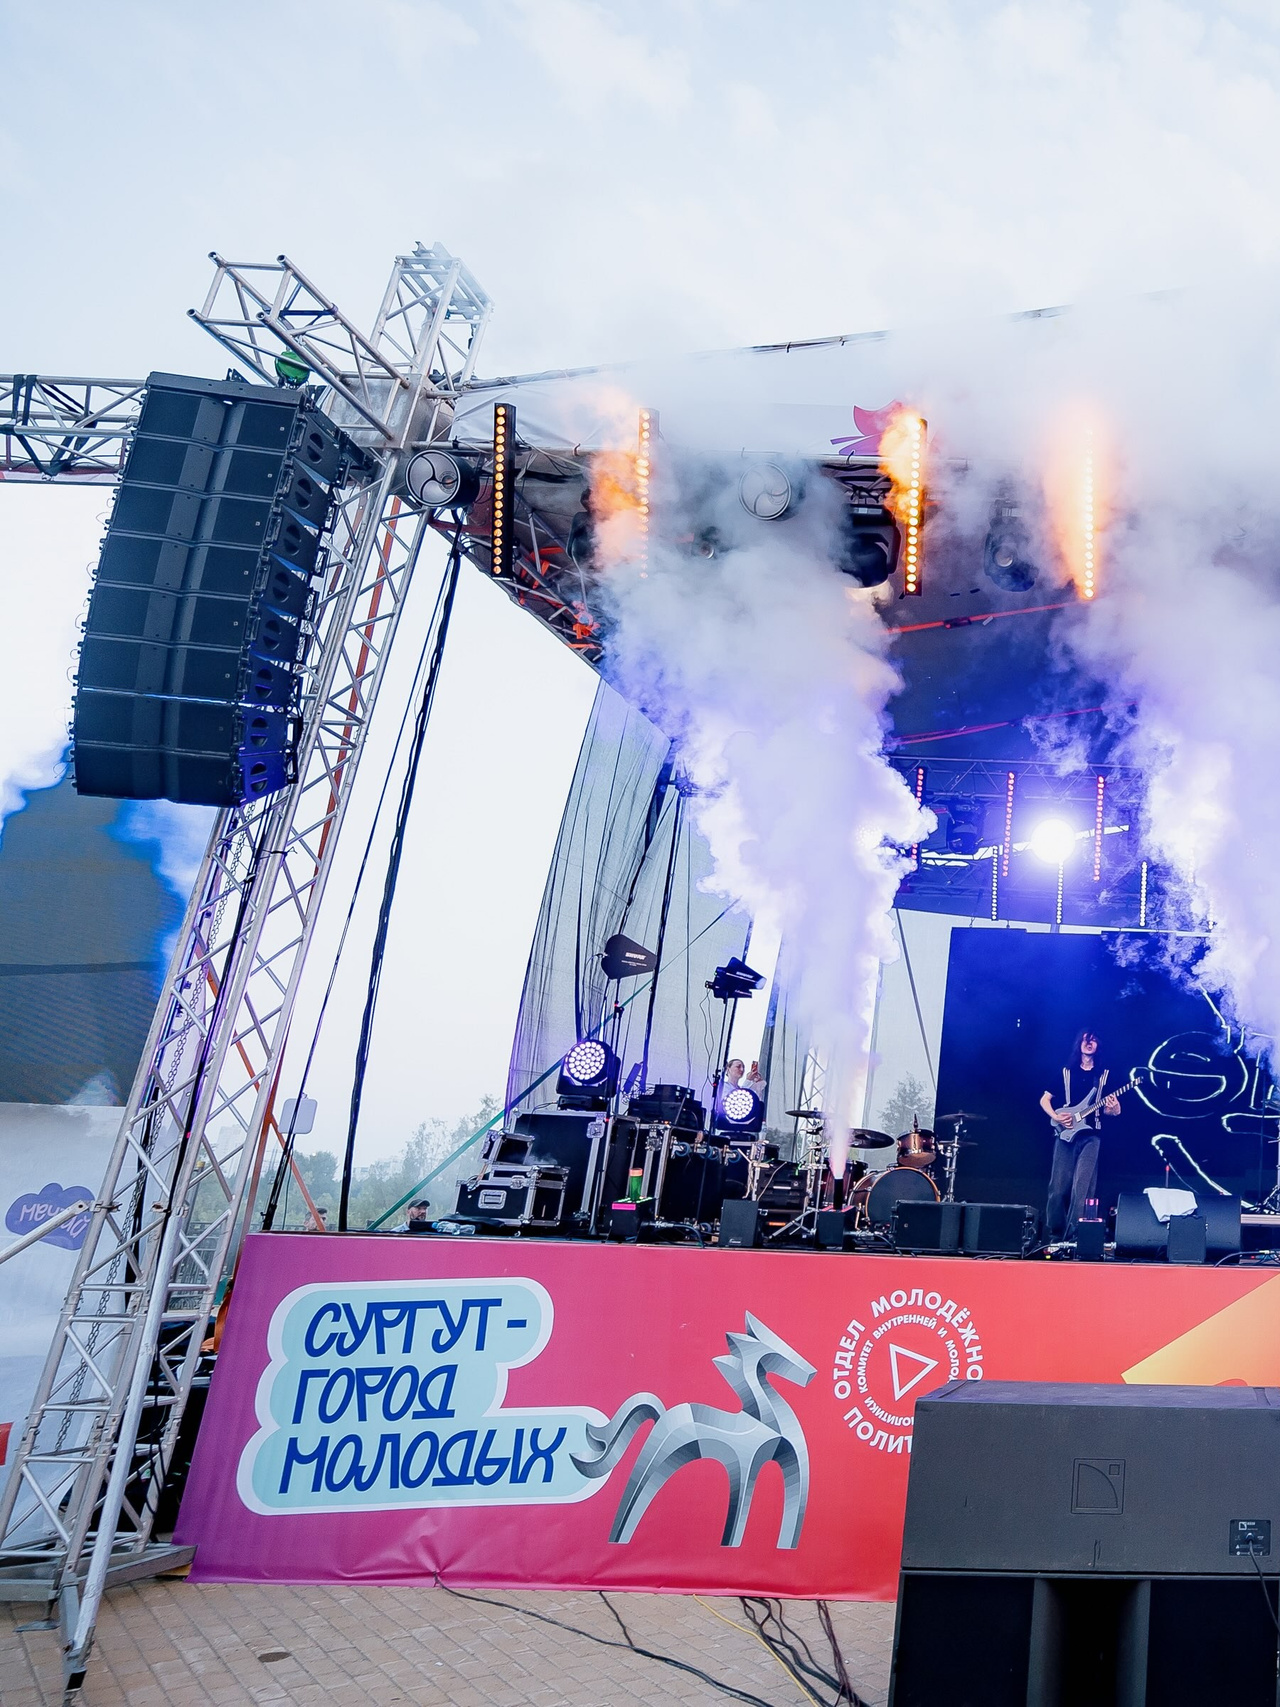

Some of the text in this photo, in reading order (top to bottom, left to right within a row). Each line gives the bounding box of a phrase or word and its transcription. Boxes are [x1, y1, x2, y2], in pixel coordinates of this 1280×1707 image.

[833, 1288, 984, 1400] ОТДЕЛ МОЛОДЁЖНО
[857, 1339, 874, 1394] КОМИТЕТ
[872, 1314, 938, 1340] ВНУТРЕННЕЙ
[937, 1326, 949, 1338] И
[292, 1364, 458, 1426] ГОРОД
[864, 1396, 915, 1427] ОЛИТИКИ
[279, 1426, 567, 1495] МОЛОДЫХ
[843, 1406, 914, 1454] ПОЛИТ
